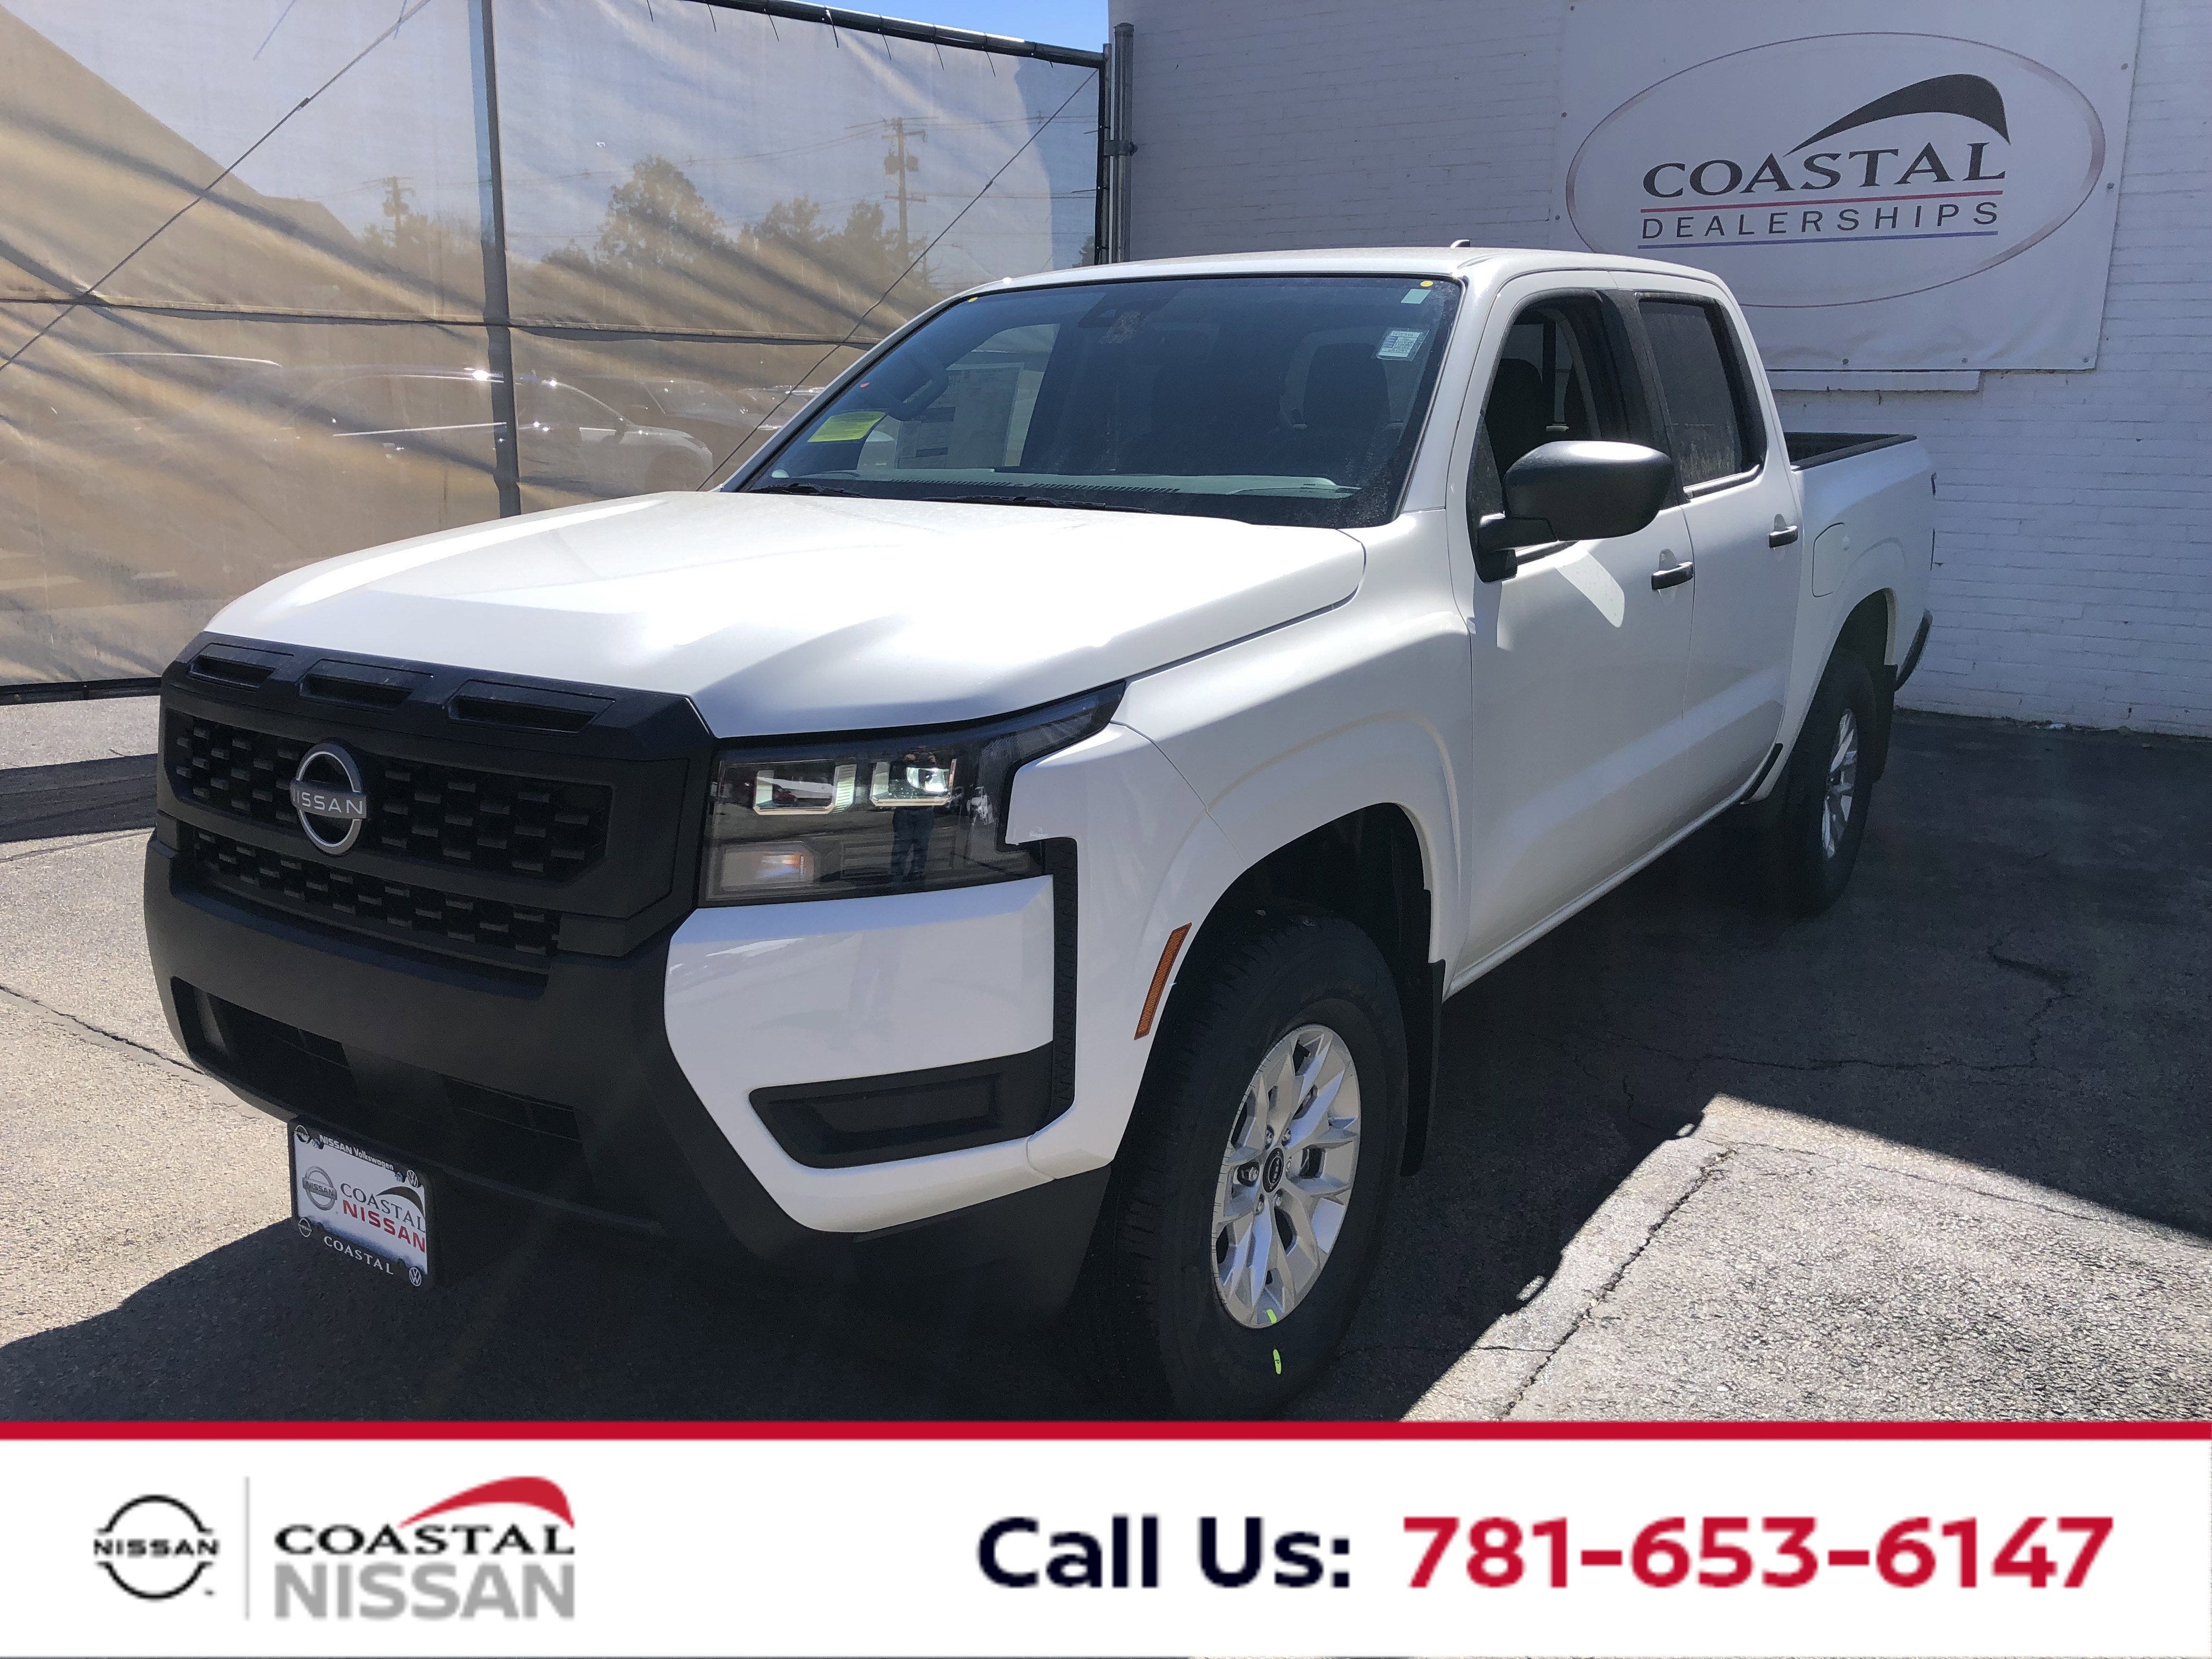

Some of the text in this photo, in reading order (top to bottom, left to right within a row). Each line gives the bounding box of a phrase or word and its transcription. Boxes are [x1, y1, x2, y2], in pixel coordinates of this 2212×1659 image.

[1643, 142, 2006, 198] COASTAL
[1643, 201, 1998, 239] DEALERSHIPS
[319, 1134, 353, 1155] NISSAN
[353, 1147, 394, 1170] Volkswagen
[305, 1178, 335, 1197] NISSAN
[340, 1183, 425, 1233] COASTAL
[342, 1199, 425, 1253] NISSAN
[324, 1235, 394, 1275] COASTAL
